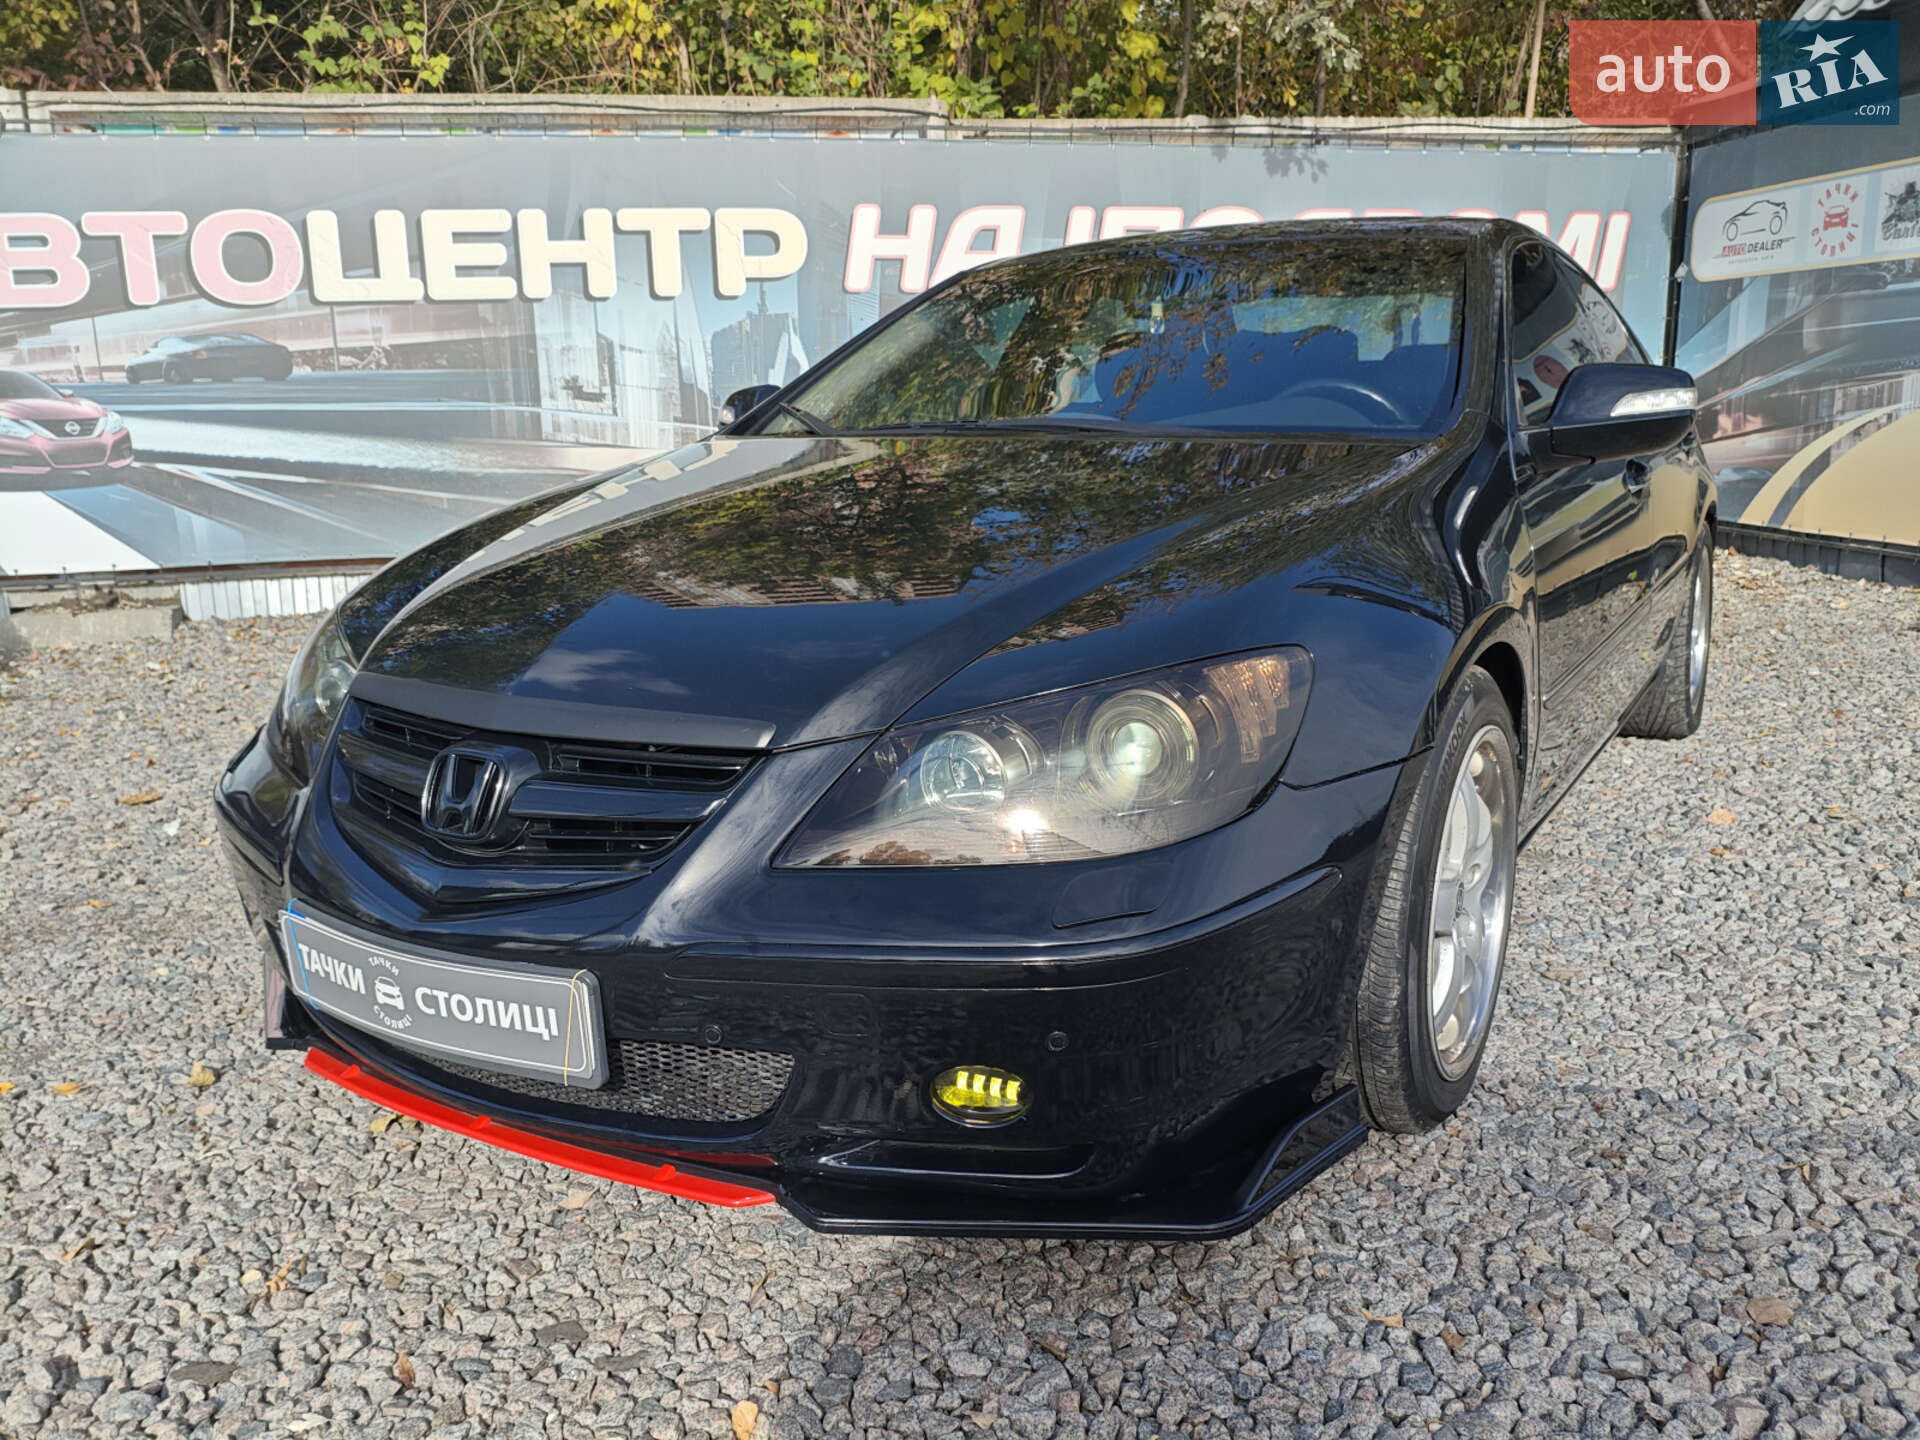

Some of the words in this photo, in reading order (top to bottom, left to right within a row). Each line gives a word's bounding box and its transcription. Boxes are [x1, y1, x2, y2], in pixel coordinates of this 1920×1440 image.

[1747, 239, 1783, 253] DEALER
[368, 955, 400, 977] ТАЧКИ
[298, 942, 367, 994] ТАЧКИ
[414, 986, 560, 1041] СТОЛИЦІ
